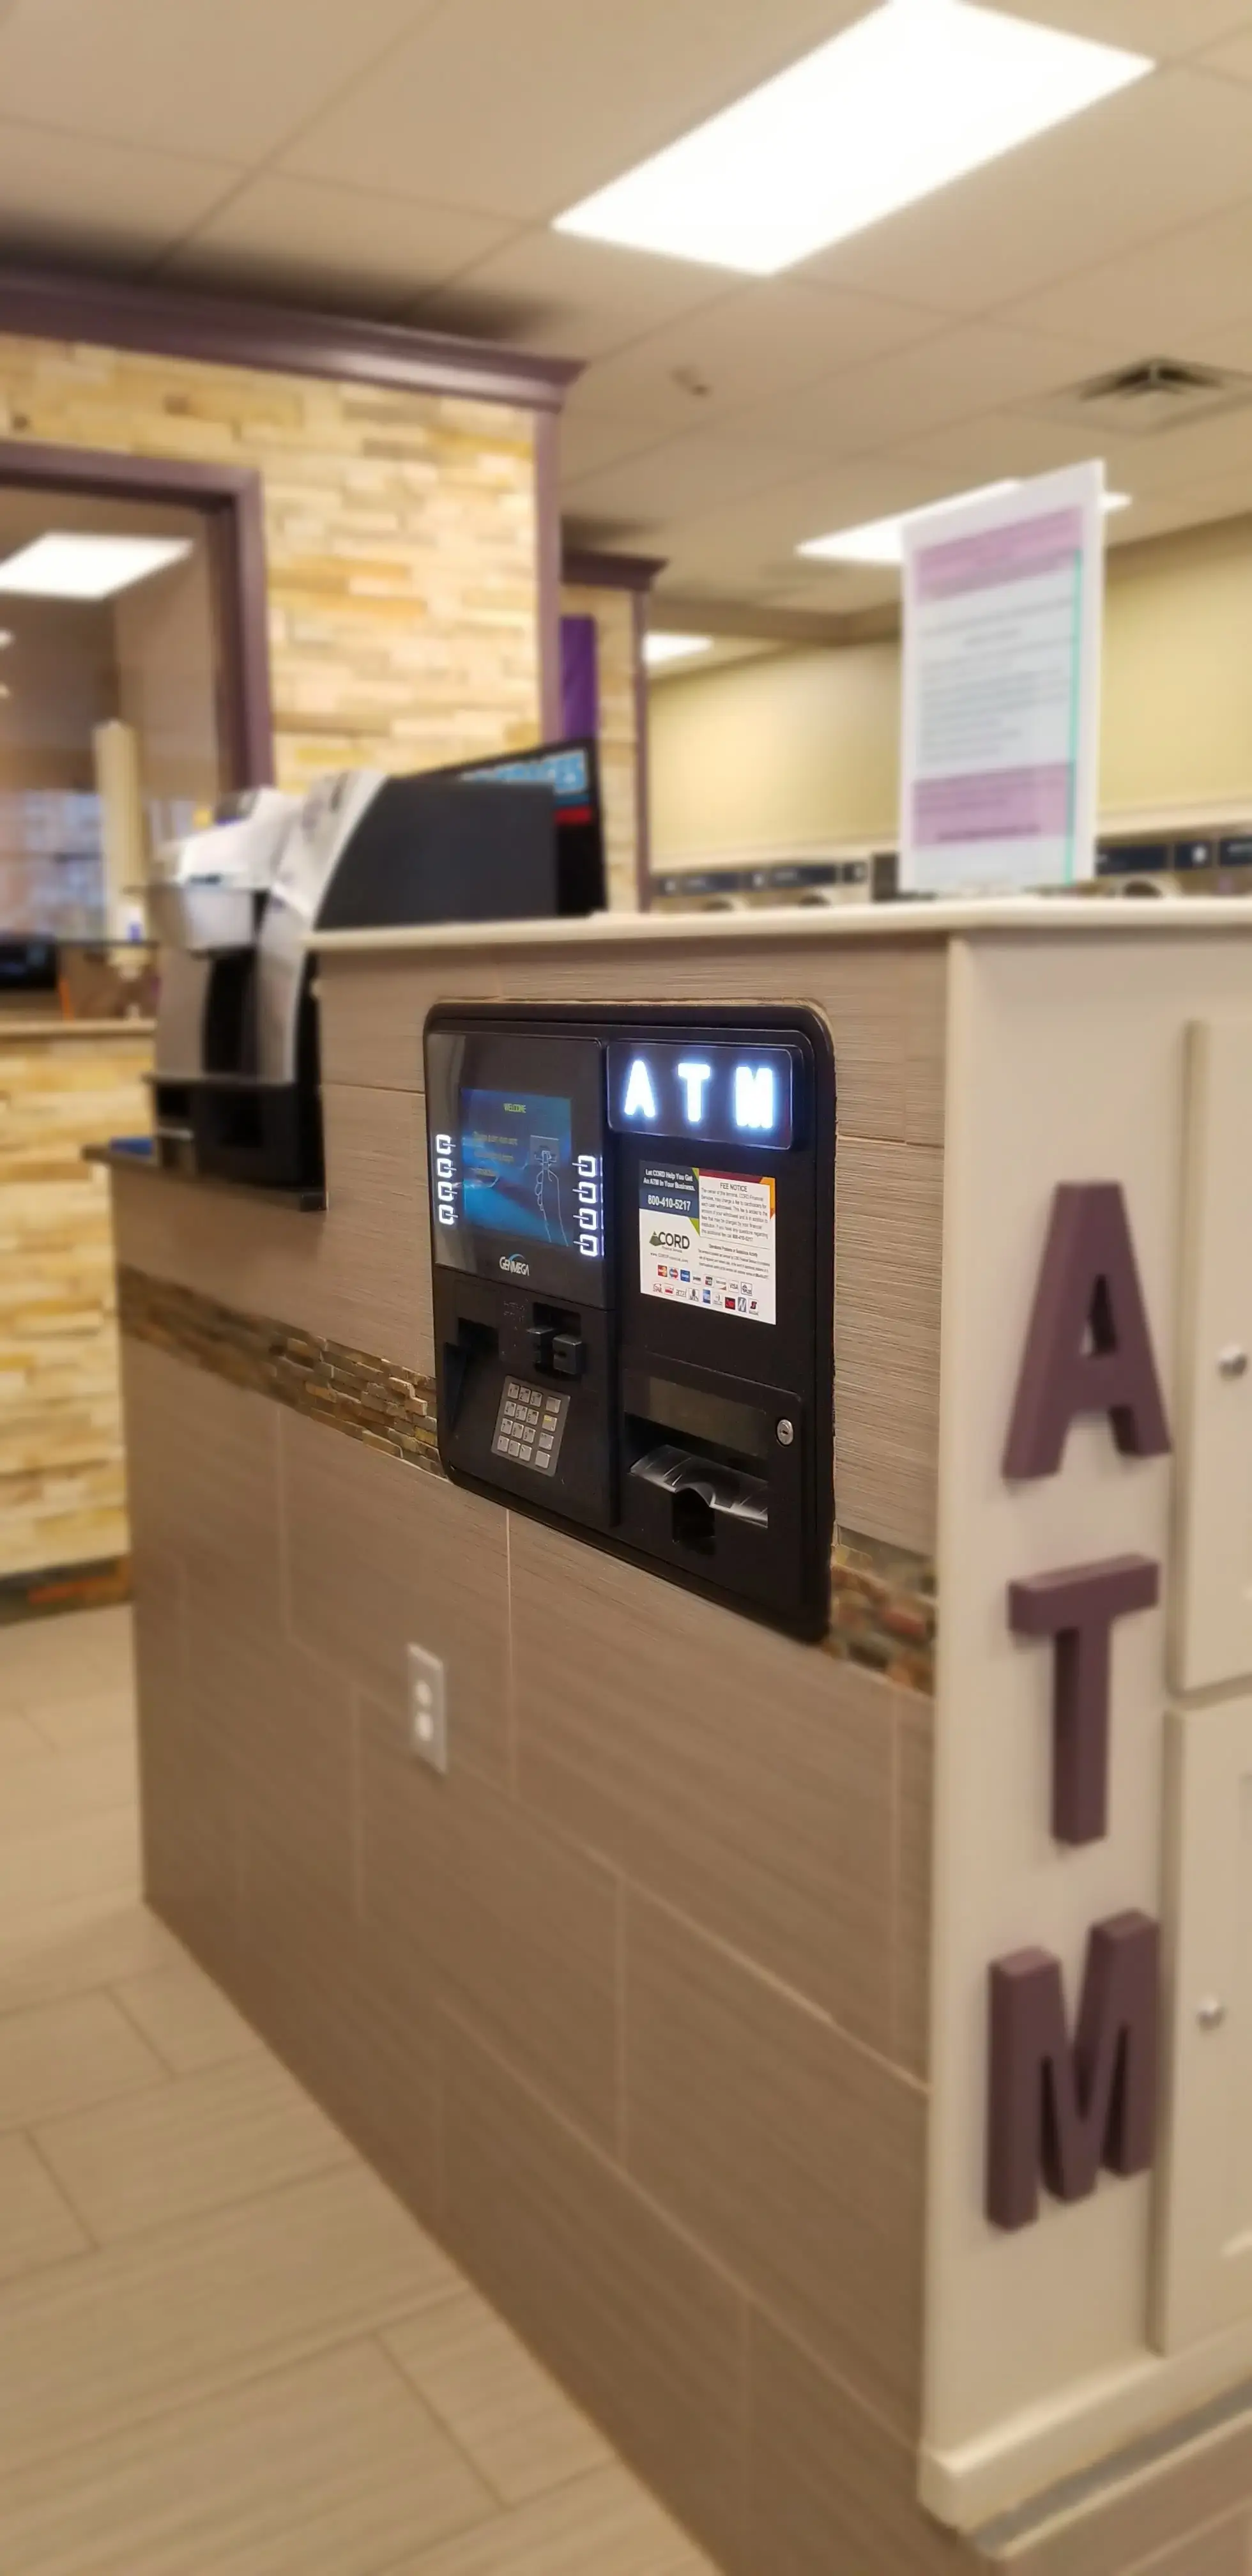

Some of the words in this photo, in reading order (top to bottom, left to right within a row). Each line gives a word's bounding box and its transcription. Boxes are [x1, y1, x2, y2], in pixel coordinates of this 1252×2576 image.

[625, 1061, 772, 1128] ATM
[666, 1172, 675, 1180] Help
[730, 1184, 747, 1192] NOTICE
[648, 1194, 691, 1211] 800-410-5217
[659, 1231, 690, 1249] CORD
